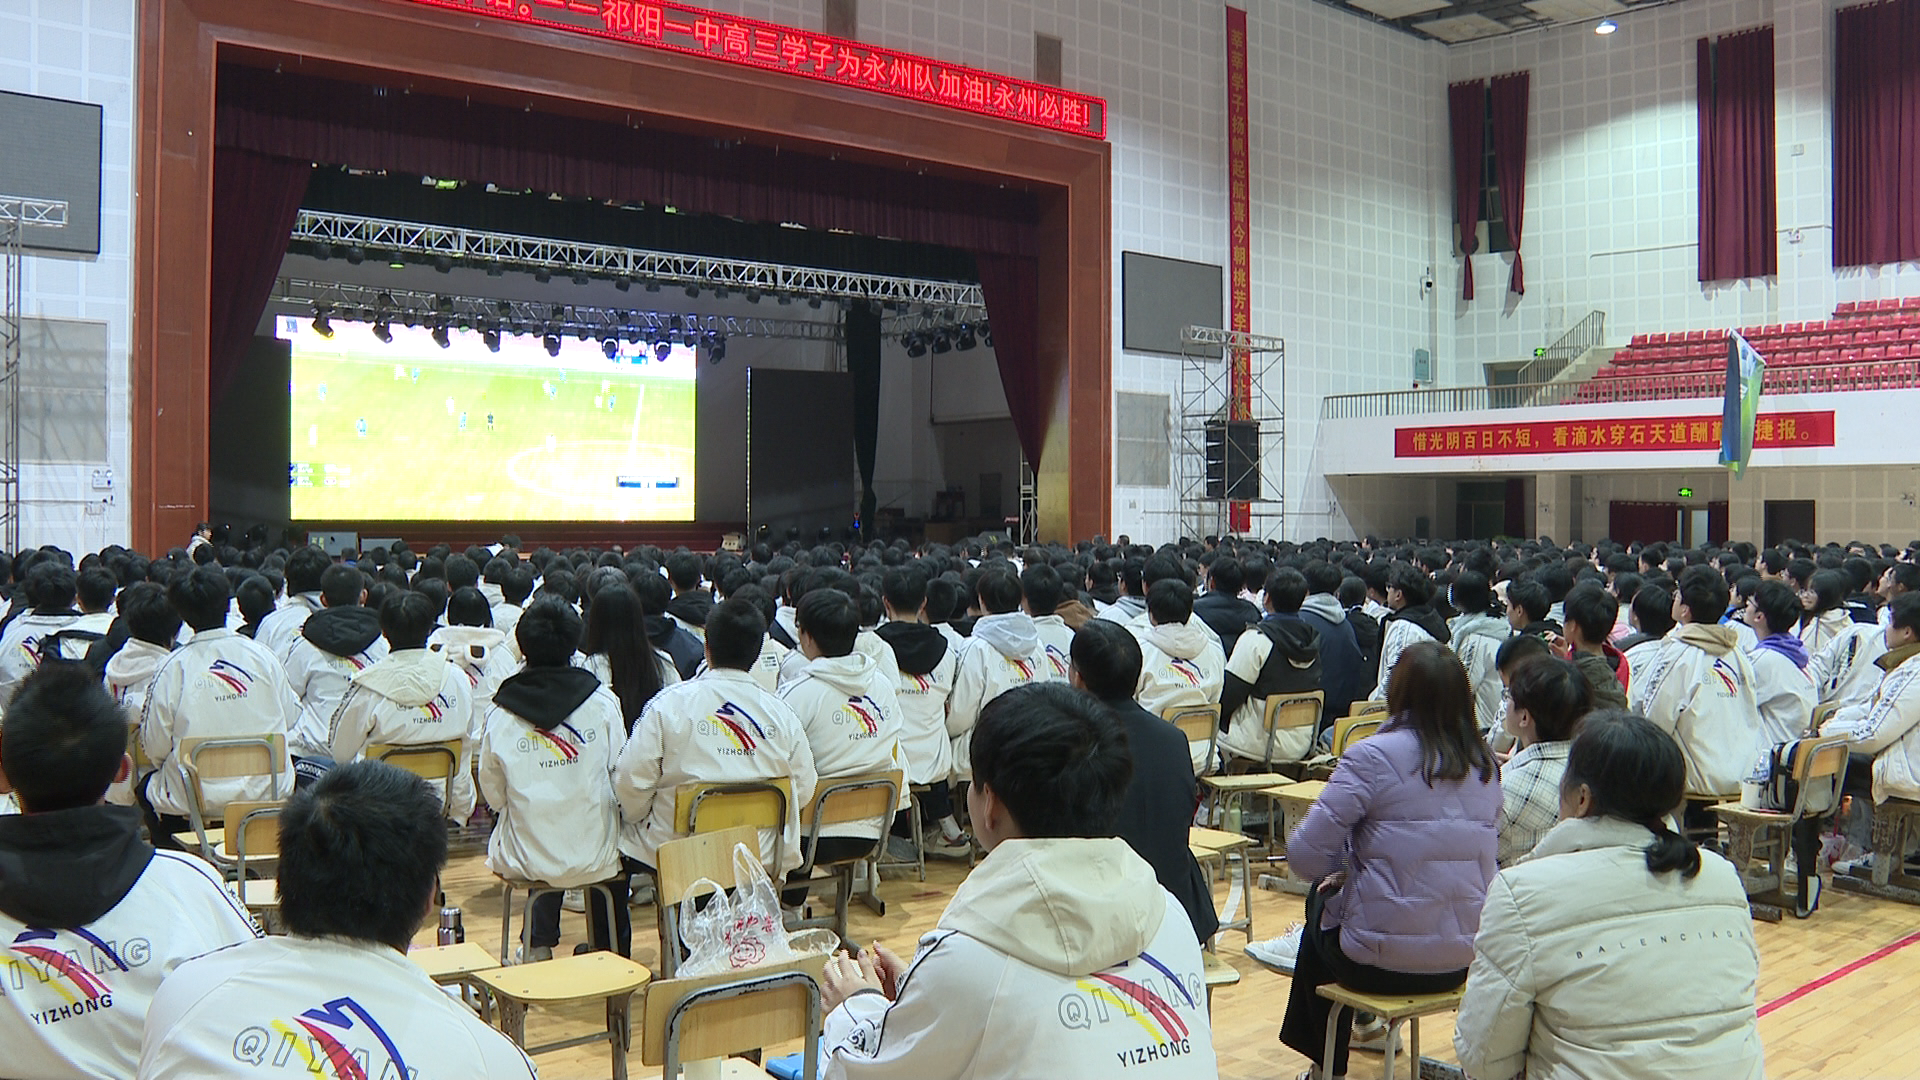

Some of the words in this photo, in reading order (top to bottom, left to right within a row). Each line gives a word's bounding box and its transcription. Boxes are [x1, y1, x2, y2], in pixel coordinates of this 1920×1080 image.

[412, 716, 442, 724] YIZHONG
[539, 756, 579, 769] YIZHONG
[716, 746, 756, 756] YIZHONG
[0, 937, 151, 996] IYANG
[30, 994, 113, 1025] YIZHONG
[1057, 972, 1203, 1030] QIYANG
[1117, 1038, 1191, 1068] YIZHONG
